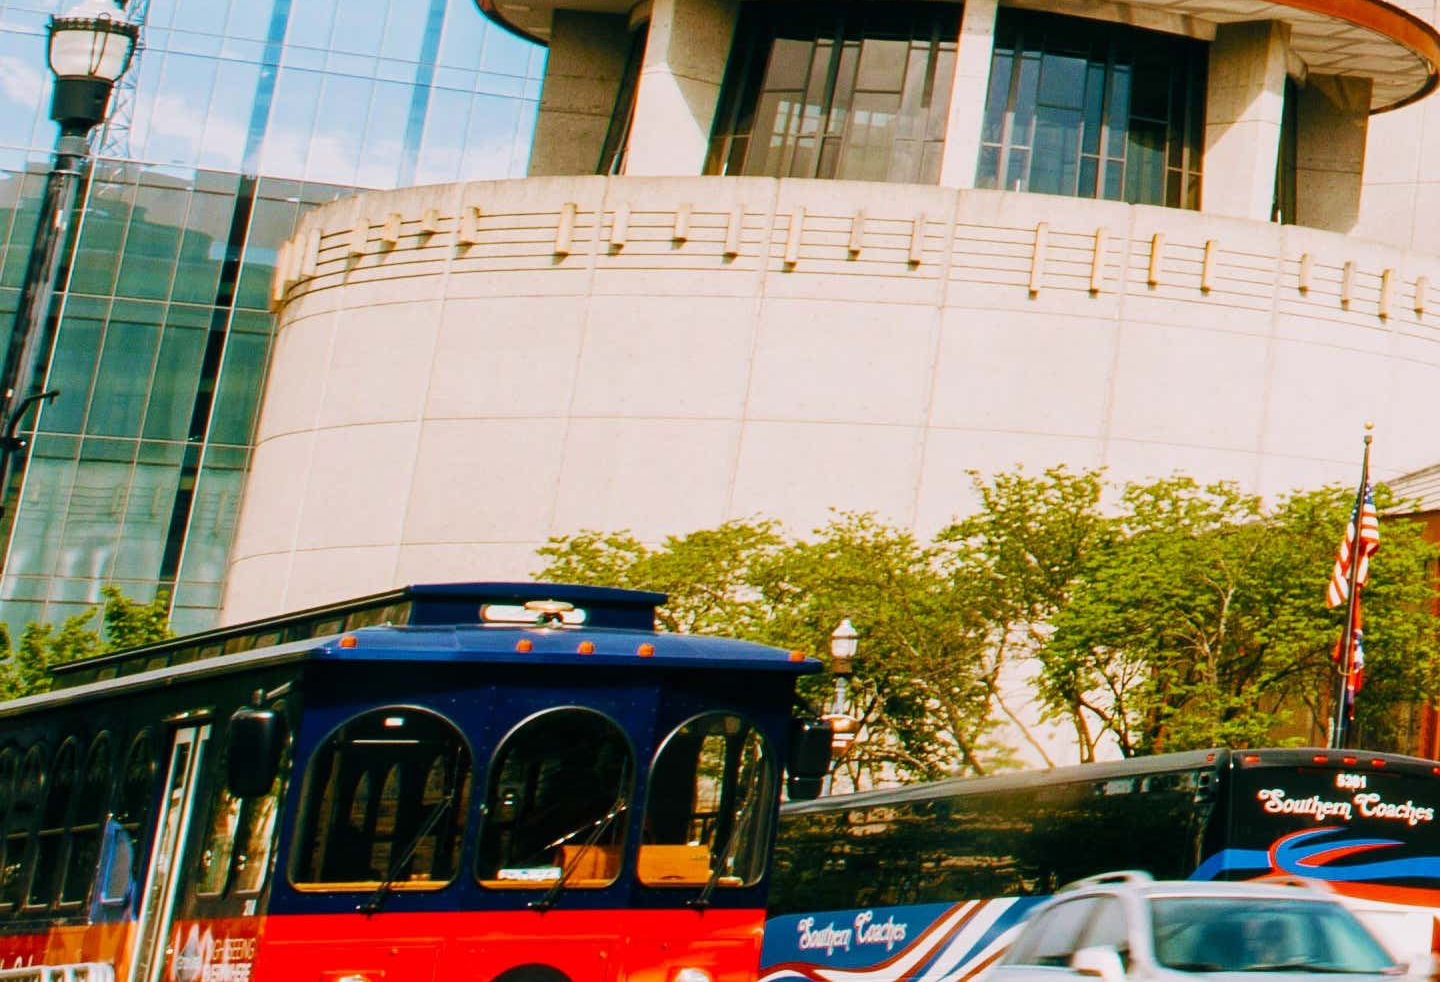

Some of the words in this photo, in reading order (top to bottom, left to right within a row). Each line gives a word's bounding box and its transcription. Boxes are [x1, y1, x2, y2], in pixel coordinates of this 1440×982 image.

[1256, 789, 1352, 821] Southern
[1353, 793, 1435, 826] Coaches
[797, 917, 852, 956] Southern
[854, 910, 908, 950] Coaches
